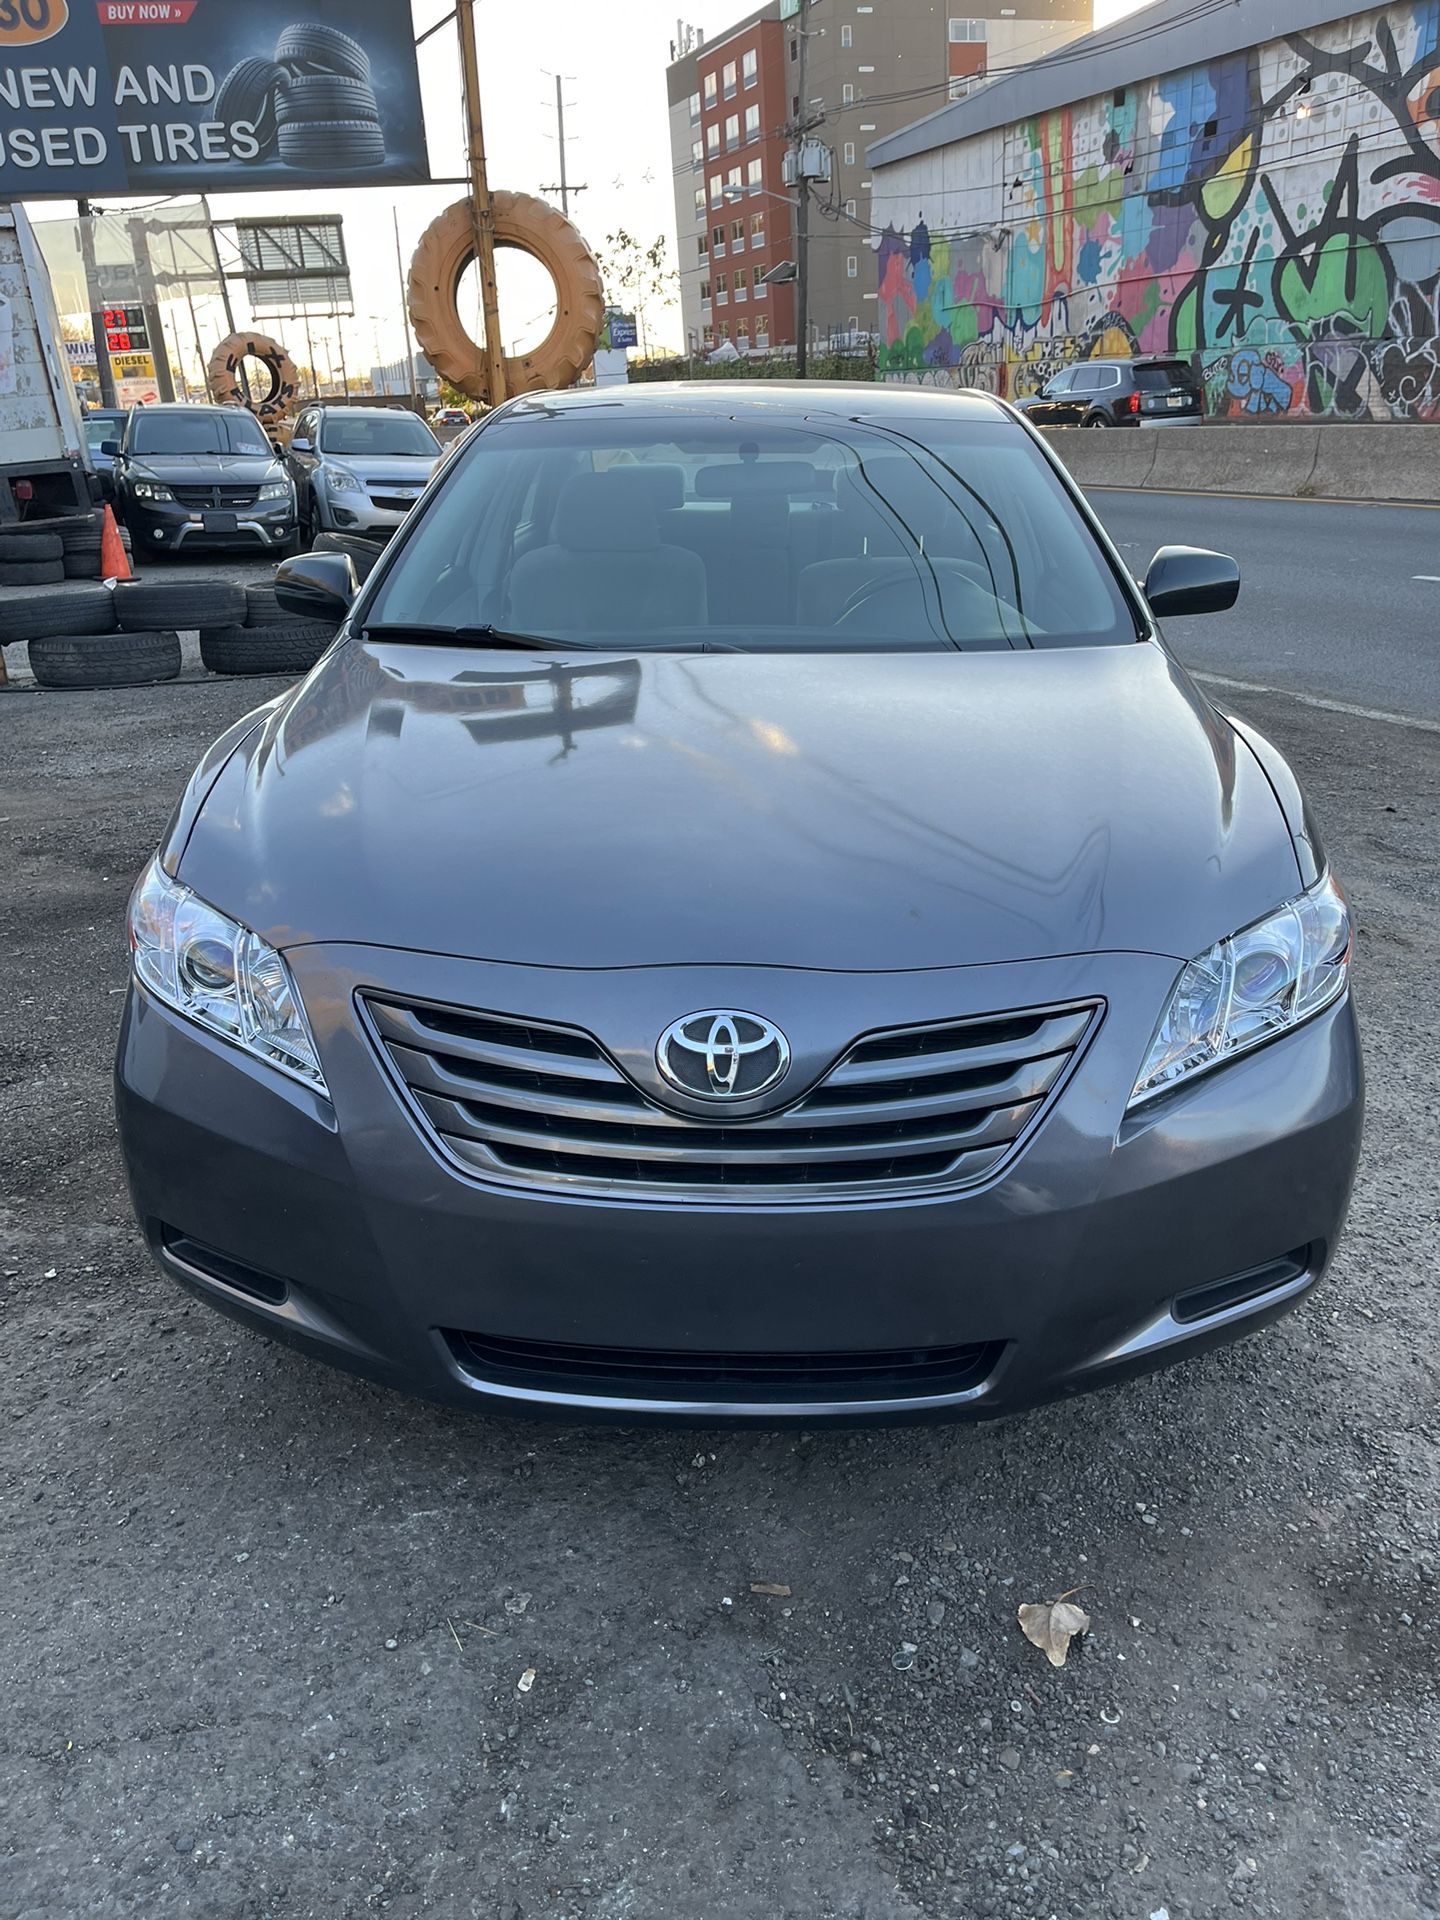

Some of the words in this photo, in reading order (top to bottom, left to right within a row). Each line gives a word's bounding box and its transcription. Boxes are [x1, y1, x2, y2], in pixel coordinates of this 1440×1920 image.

[108, 6, 134, 20] BUY
[139, 5, 170, 19] NOW
[115, 64, 216, 105] AND
[0, 127, 108, 168] SED
[117, 121, 260, 163] TIRES
[114, 355, 149, 366] DIESEL
